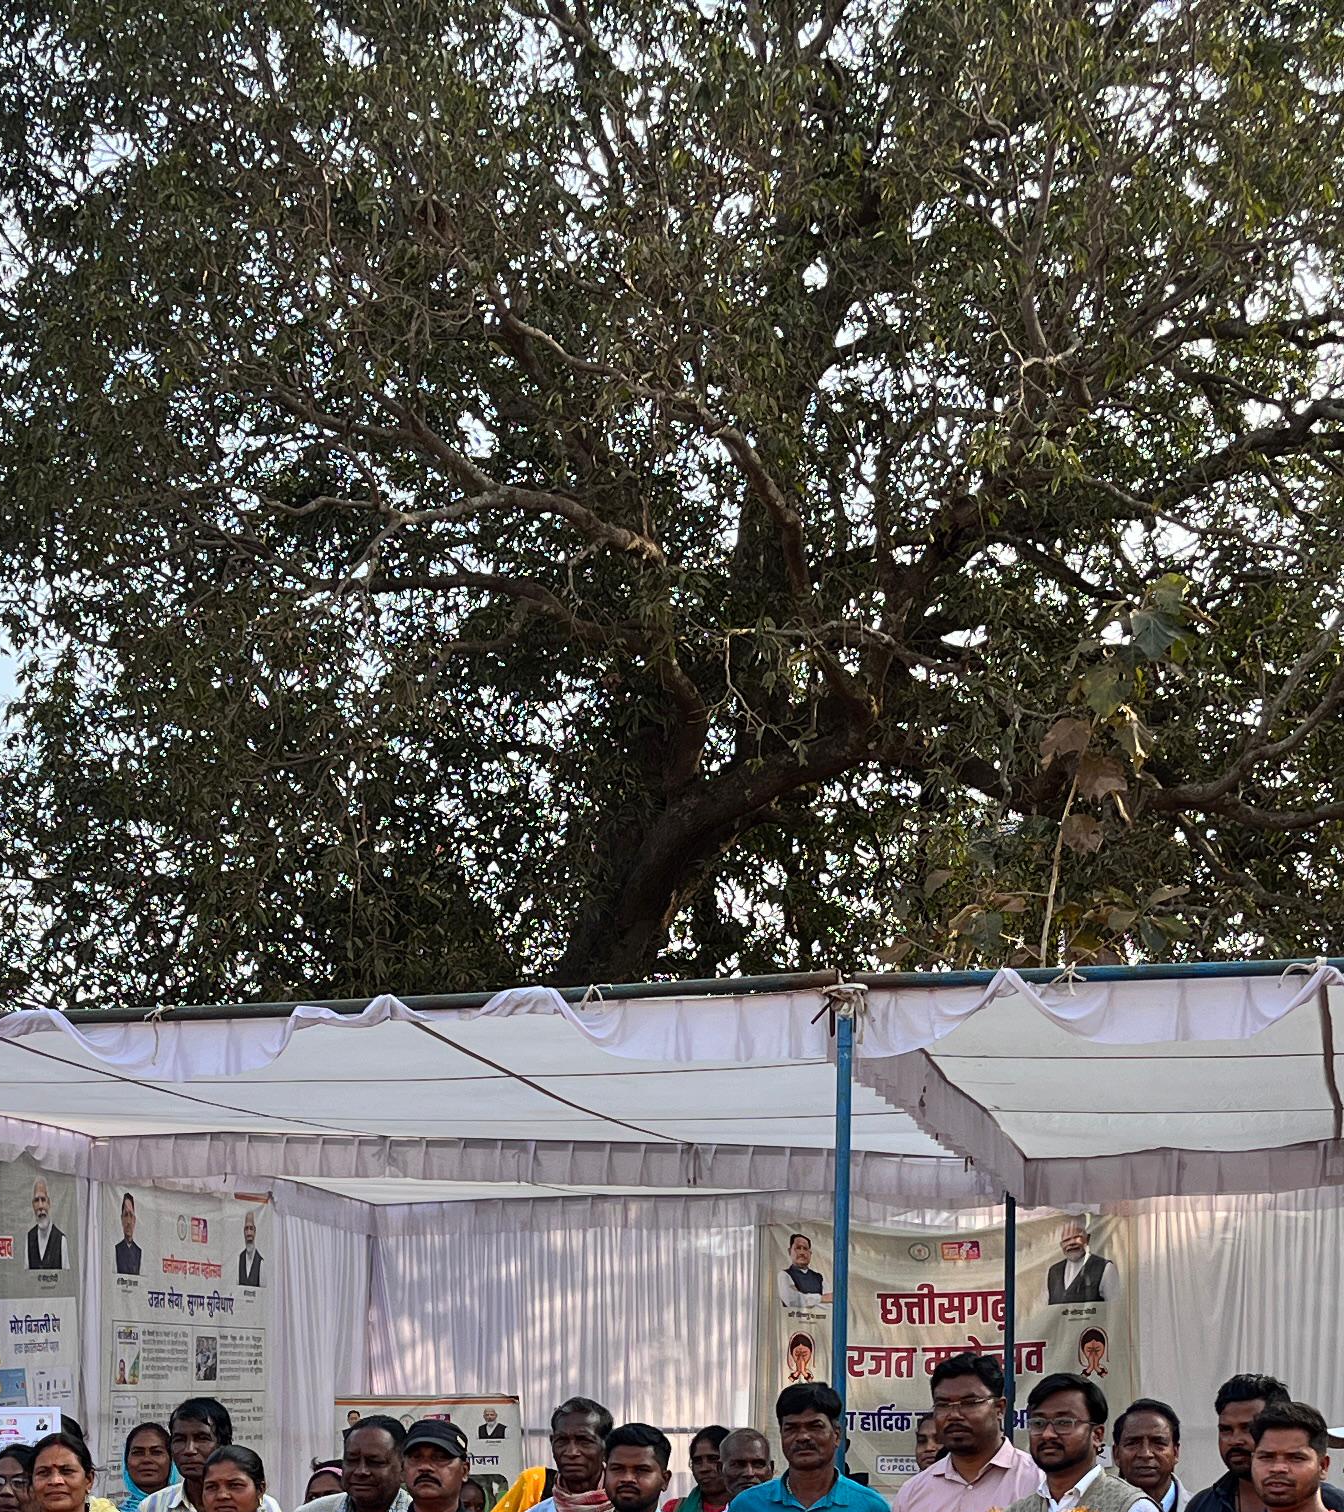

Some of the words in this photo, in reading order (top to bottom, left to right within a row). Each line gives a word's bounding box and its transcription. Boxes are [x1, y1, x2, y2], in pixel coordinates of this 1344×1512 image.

[148, 1291, 166, 1309] उन्नत
[187, 1294, 205, 1317] सुगम
[877, 1284, 1005, 1330] छत्तीसगढ़
[847, 1346, 916, 1378] रजत
[859, 1404, 911, 1431] हार्दिक
